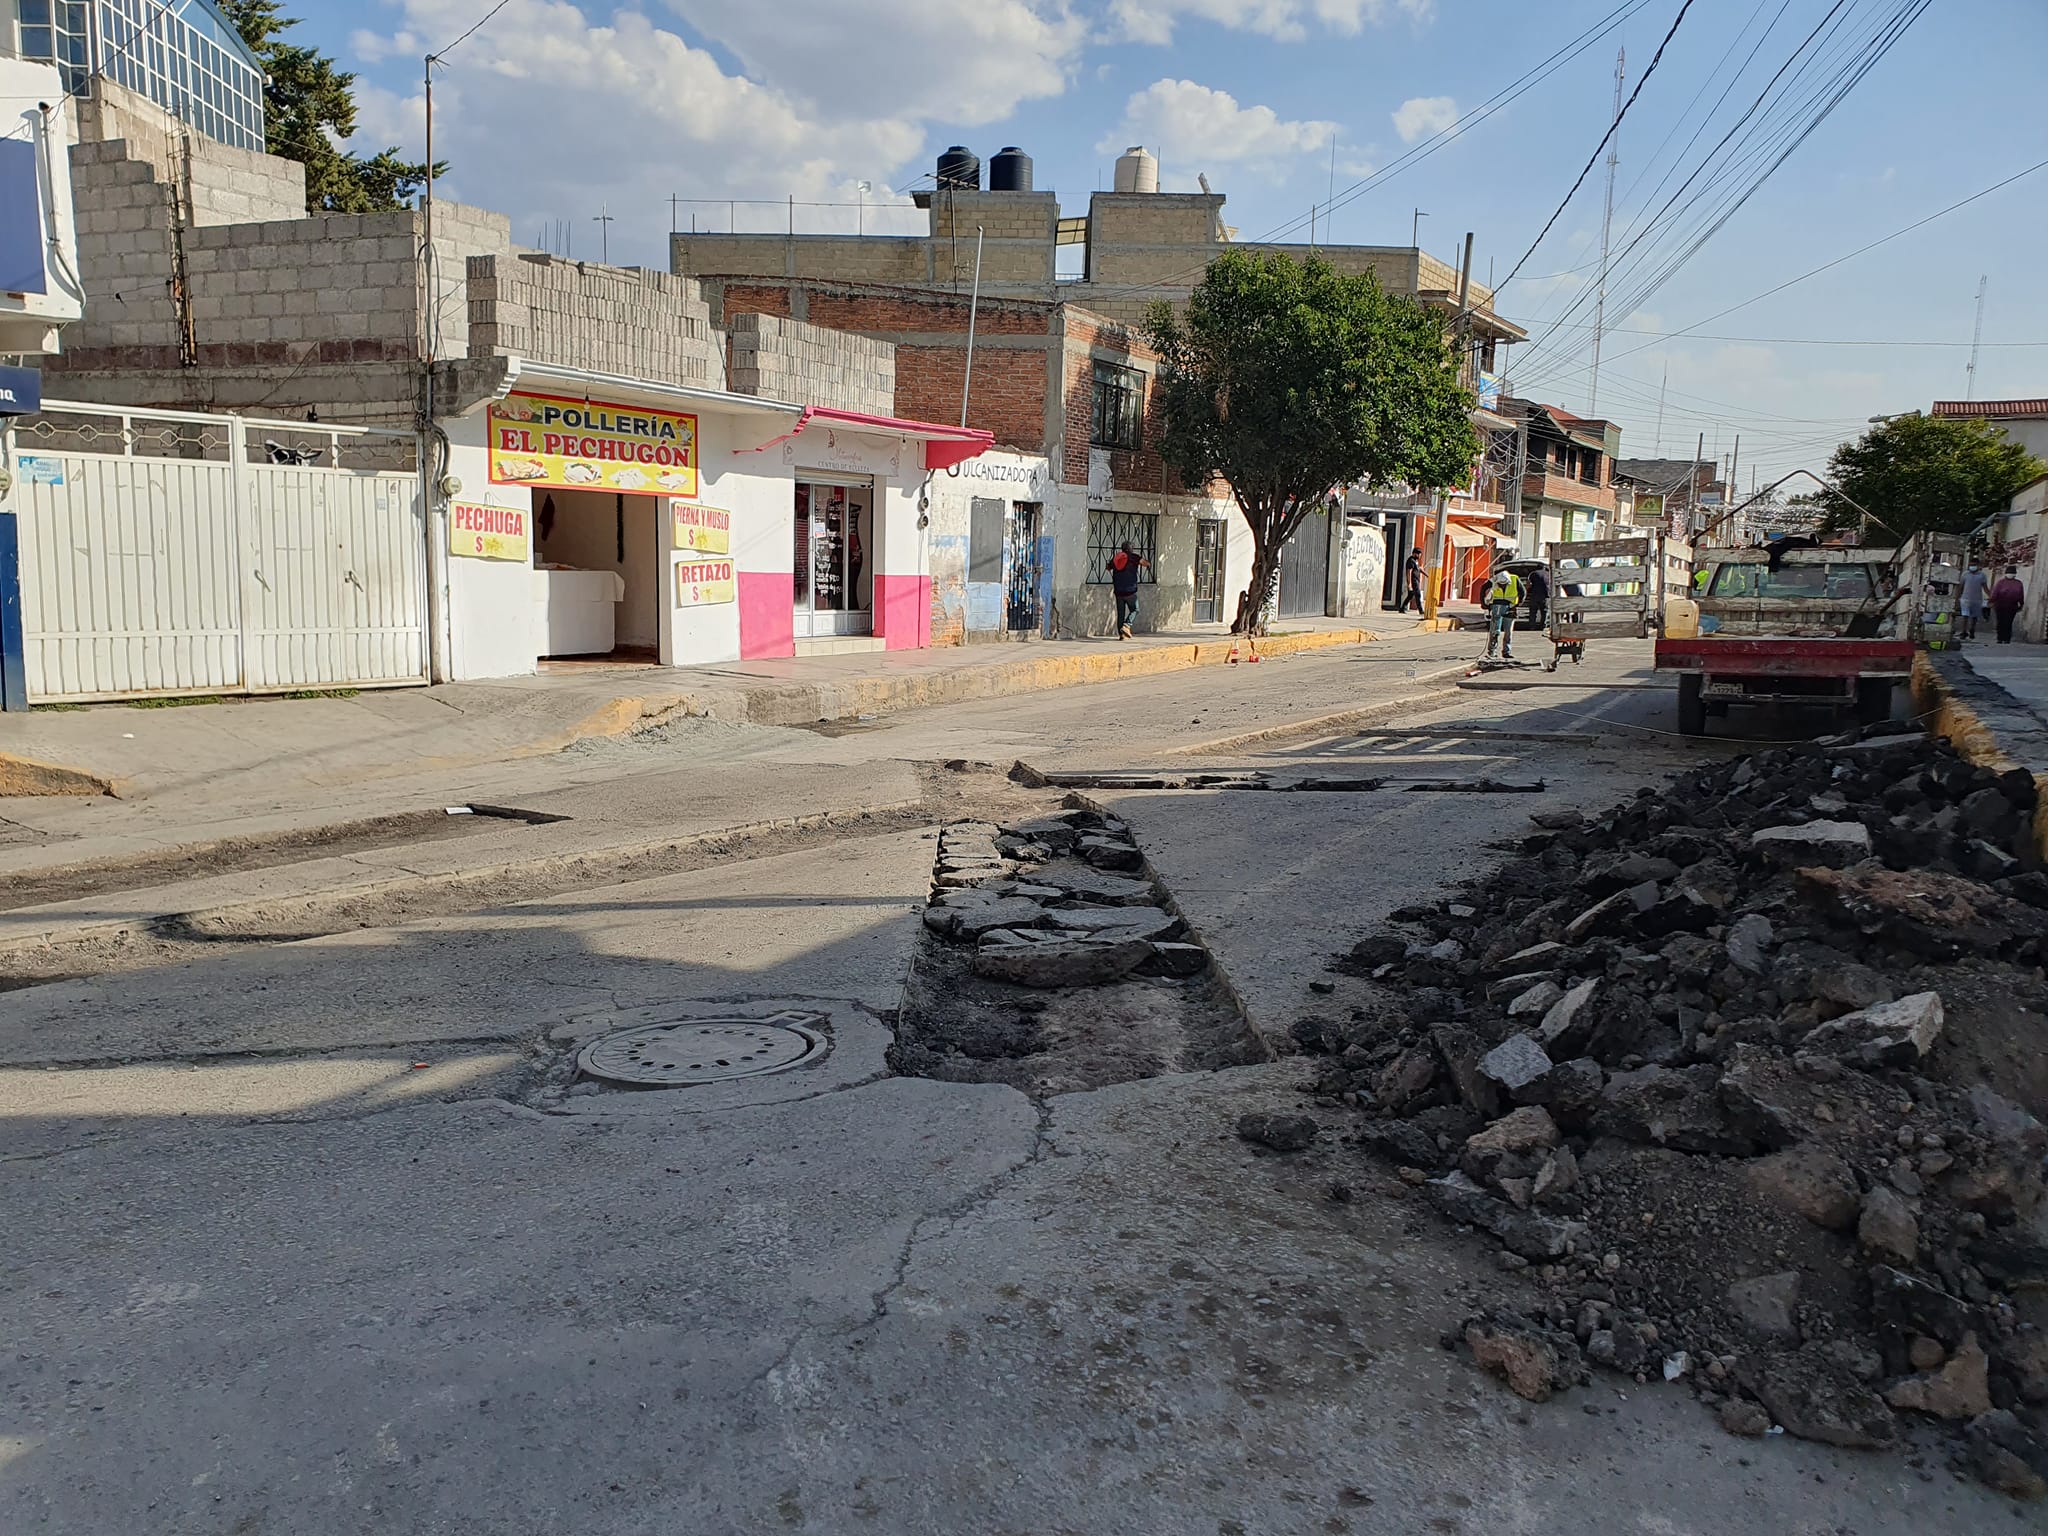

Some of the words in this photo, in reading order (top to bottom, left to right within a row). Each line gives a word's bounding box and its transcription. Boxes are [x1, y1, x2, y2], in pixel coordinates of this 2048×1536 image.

[543, 406, 676, 439] POLLERÍA
[500, 429, 538, 453] EL
[544, 433, 690, 468] PECHUGÓN
[455, 506, 524, 537] PECHUGA
[676, 505, 699, 526] PIERNA
[701, 508, 706, 527] Y
[706, 510, 730, 531] MUSLO
[475, 536, 483, 553] $
[688, 529, 694, 546] $
[681, 563, 731, 584] RETAZO
[693, 586, 699, 601] $
